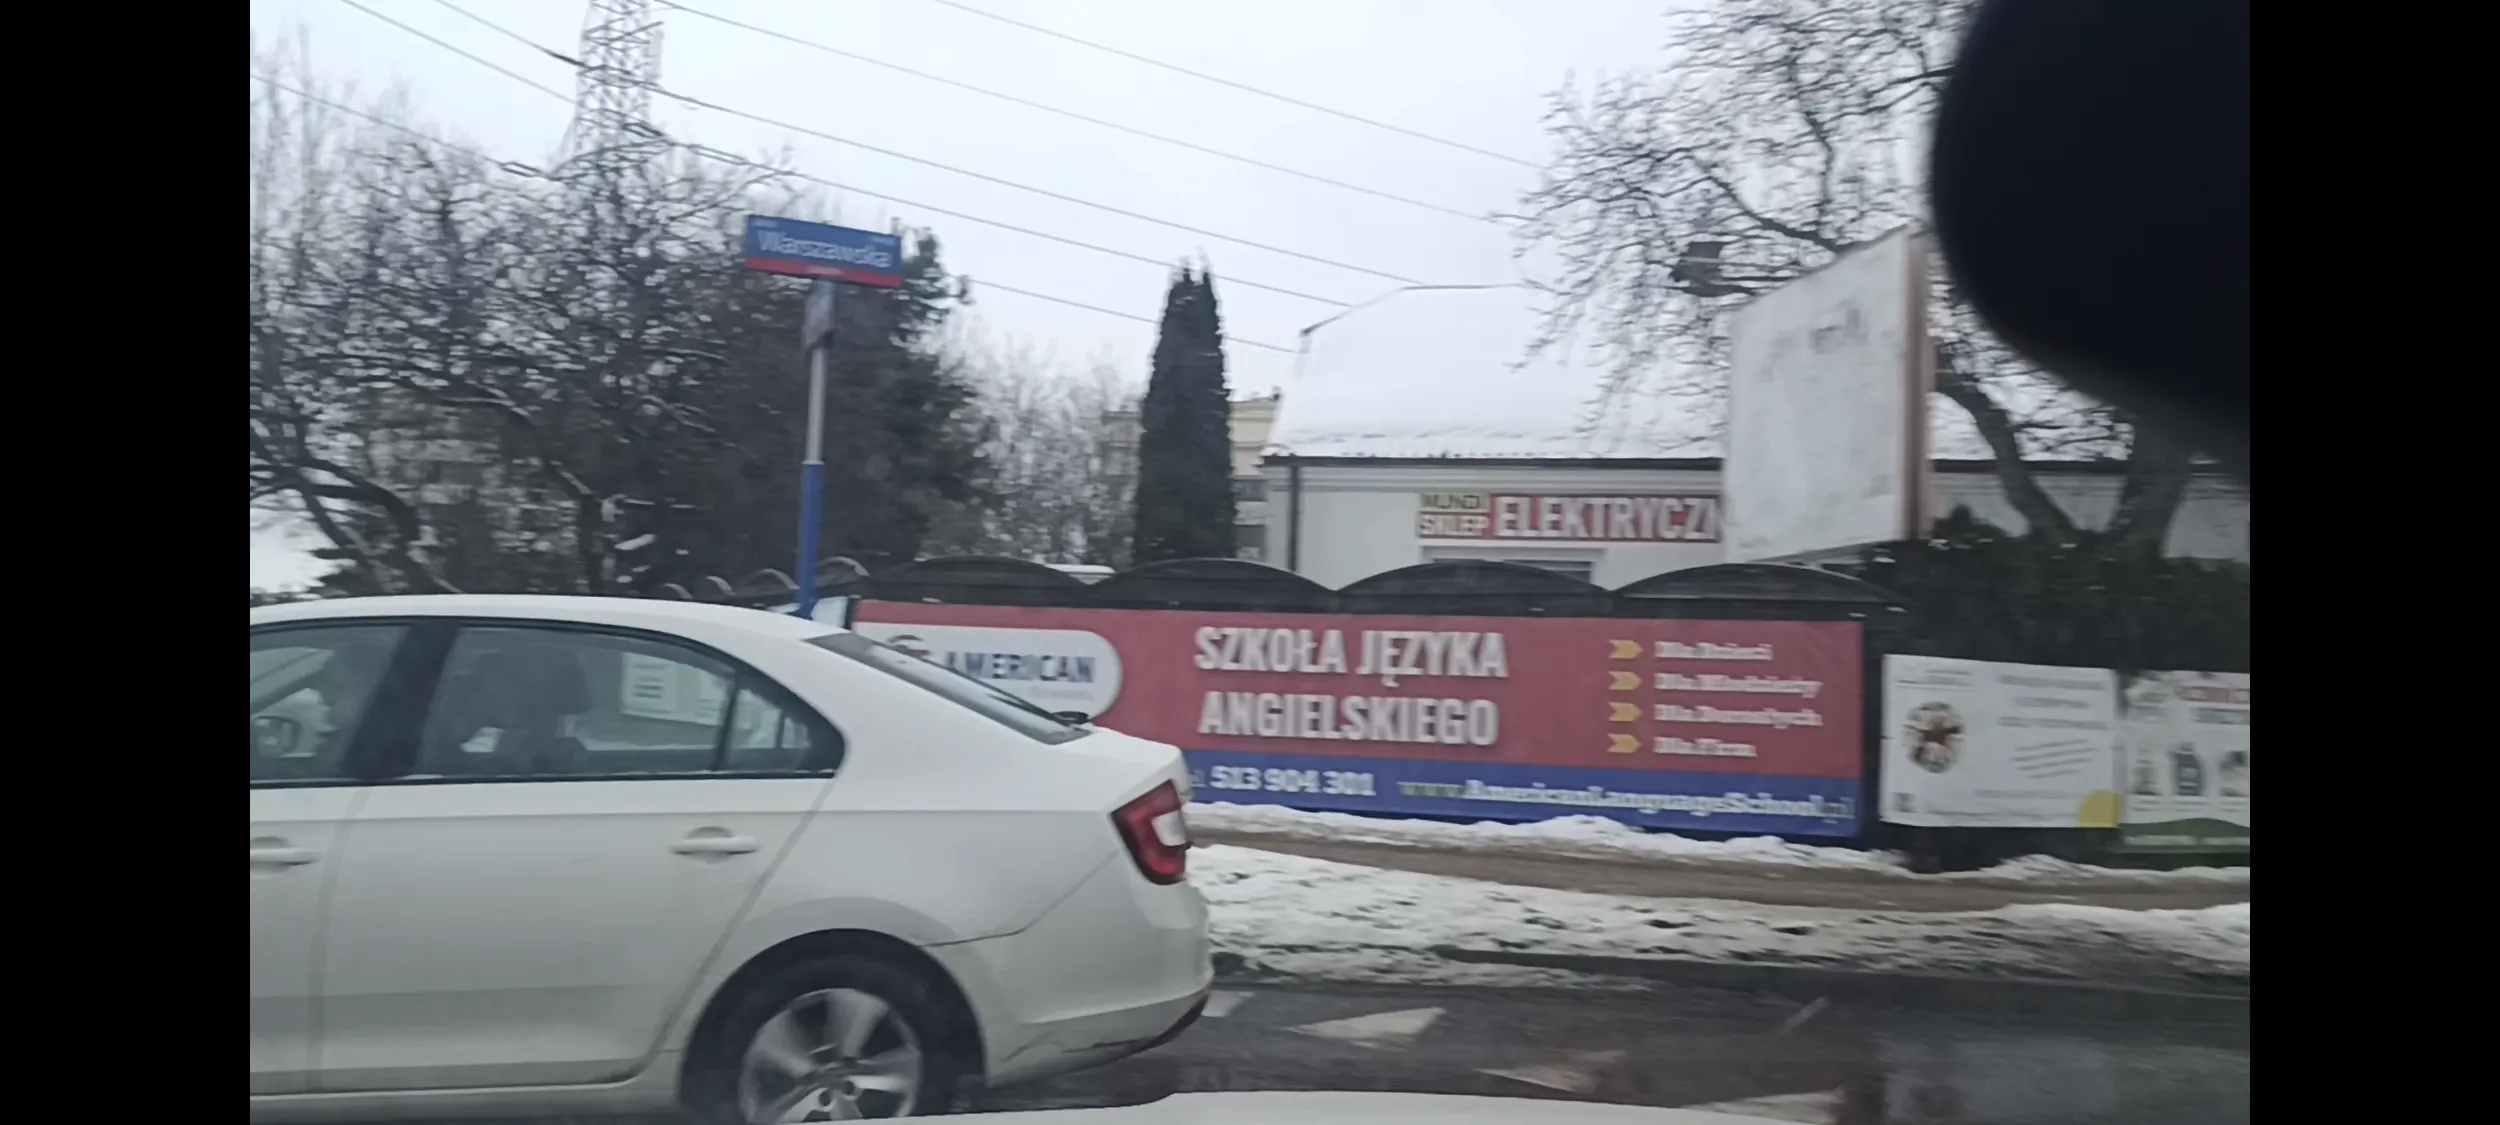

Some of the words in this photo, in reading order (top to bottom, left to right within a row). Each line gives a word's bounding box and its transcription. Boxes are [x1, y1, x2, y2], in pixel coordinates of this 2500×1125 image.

[757, 229, 892, 268] Warszawska
[1420, 514, 1490, 535] SKLEP
[1195, 627, 1346, 673] SZKOŁA
[1356, 630, 1509, 687] JĘZYKA
[1198, 692, 1497, 745] ANGIELSKIEGO
[1210, 765, 1261, 790] 513
[1263, 768, 1319, 793] 904
